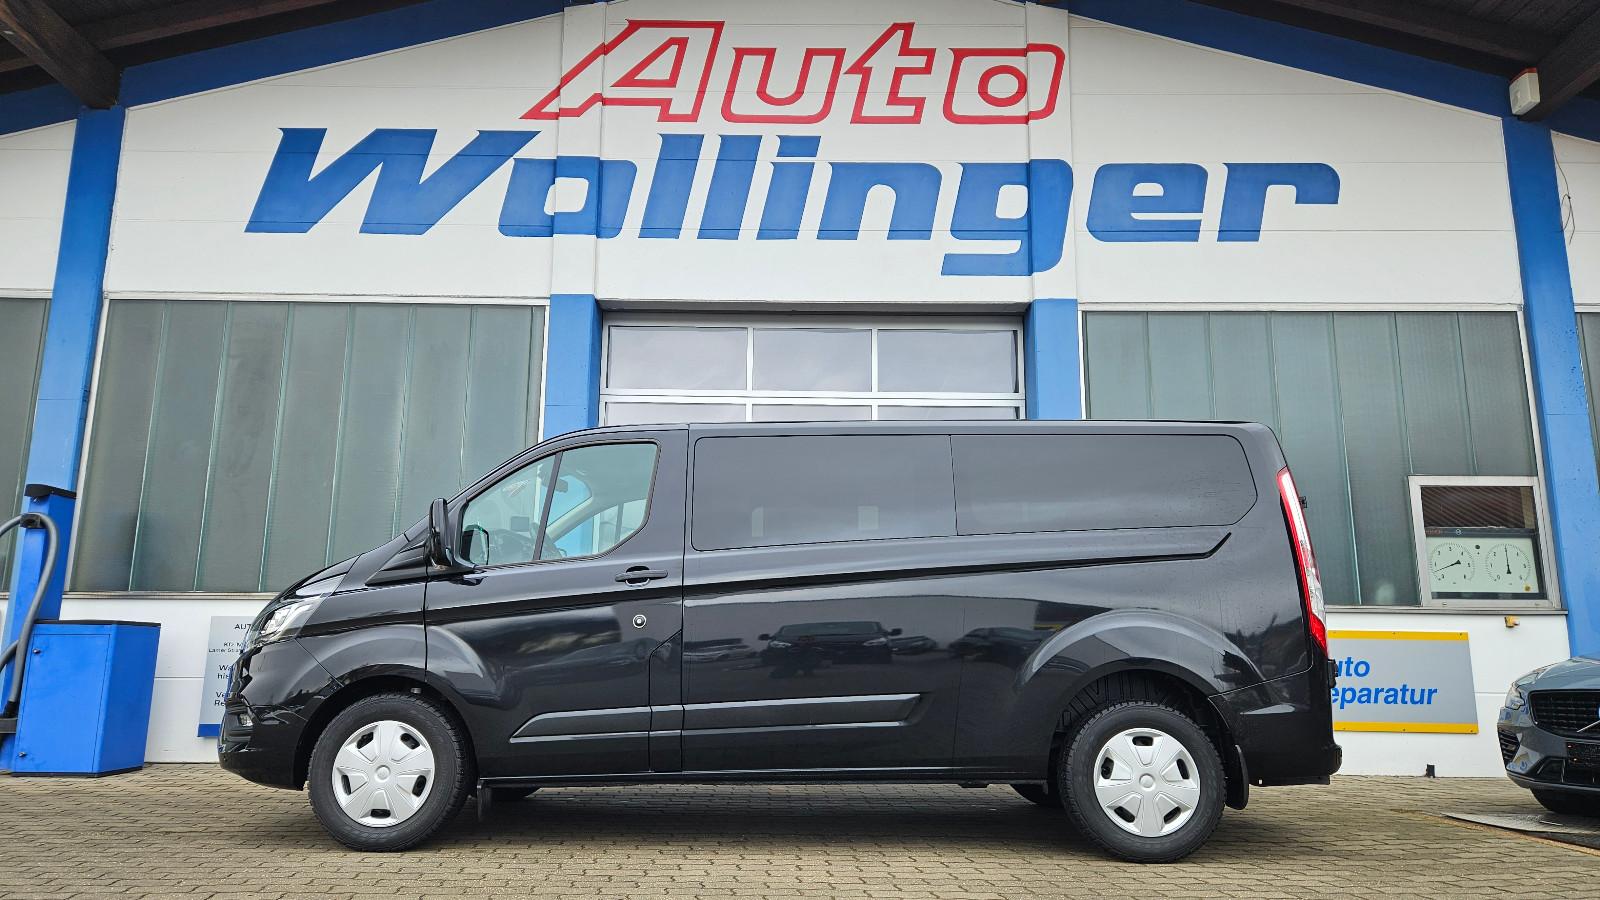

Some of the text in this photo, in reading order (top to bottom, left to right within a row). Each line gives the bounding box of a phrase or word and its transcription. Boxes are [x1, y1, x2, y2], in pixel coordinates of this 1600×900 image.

[519, 19, 1065, 125] Auto
[244, 128, 1341, 277] Wollinger
[1331, 684, 1438, 709] eparatur
